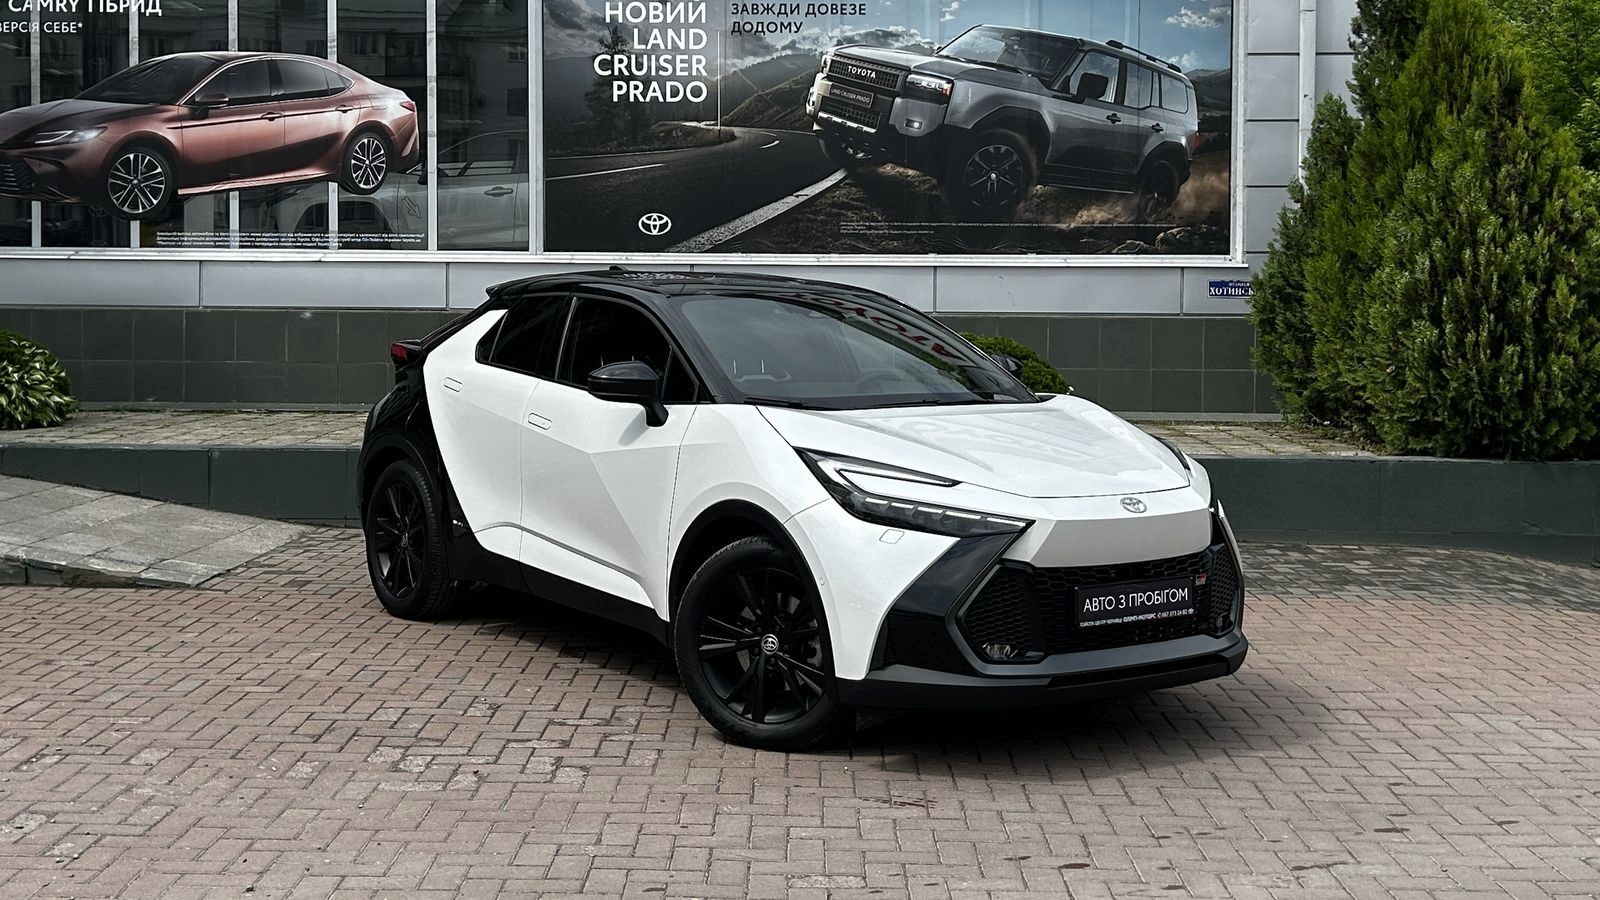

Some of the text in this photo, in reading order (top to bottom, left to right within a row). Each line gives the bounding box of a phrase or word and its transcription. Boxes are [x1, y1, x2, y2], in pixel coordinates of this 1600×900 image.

[8, 0, 79, 12] CAMRY
[605, 0, 707, 23] НОВИЙ
[731, 3, 866, 17] ЗАВЖДИ ДОВЕЗЕ
[0, 21, 39, 33] ЕРСІЯ
[731, 21, 803, 35] ДОДОМУ
[633, 28, 708, 50] LAND
[593, 54, 708, 76] CRUISER
[848, 65, 876, 79] TOYOTA
[612, 81, 708, 102] PRADO
[1209, 287, 1254, 295] ХОТИНСЬ
[1083, 596, 1115, 612] АВТО
